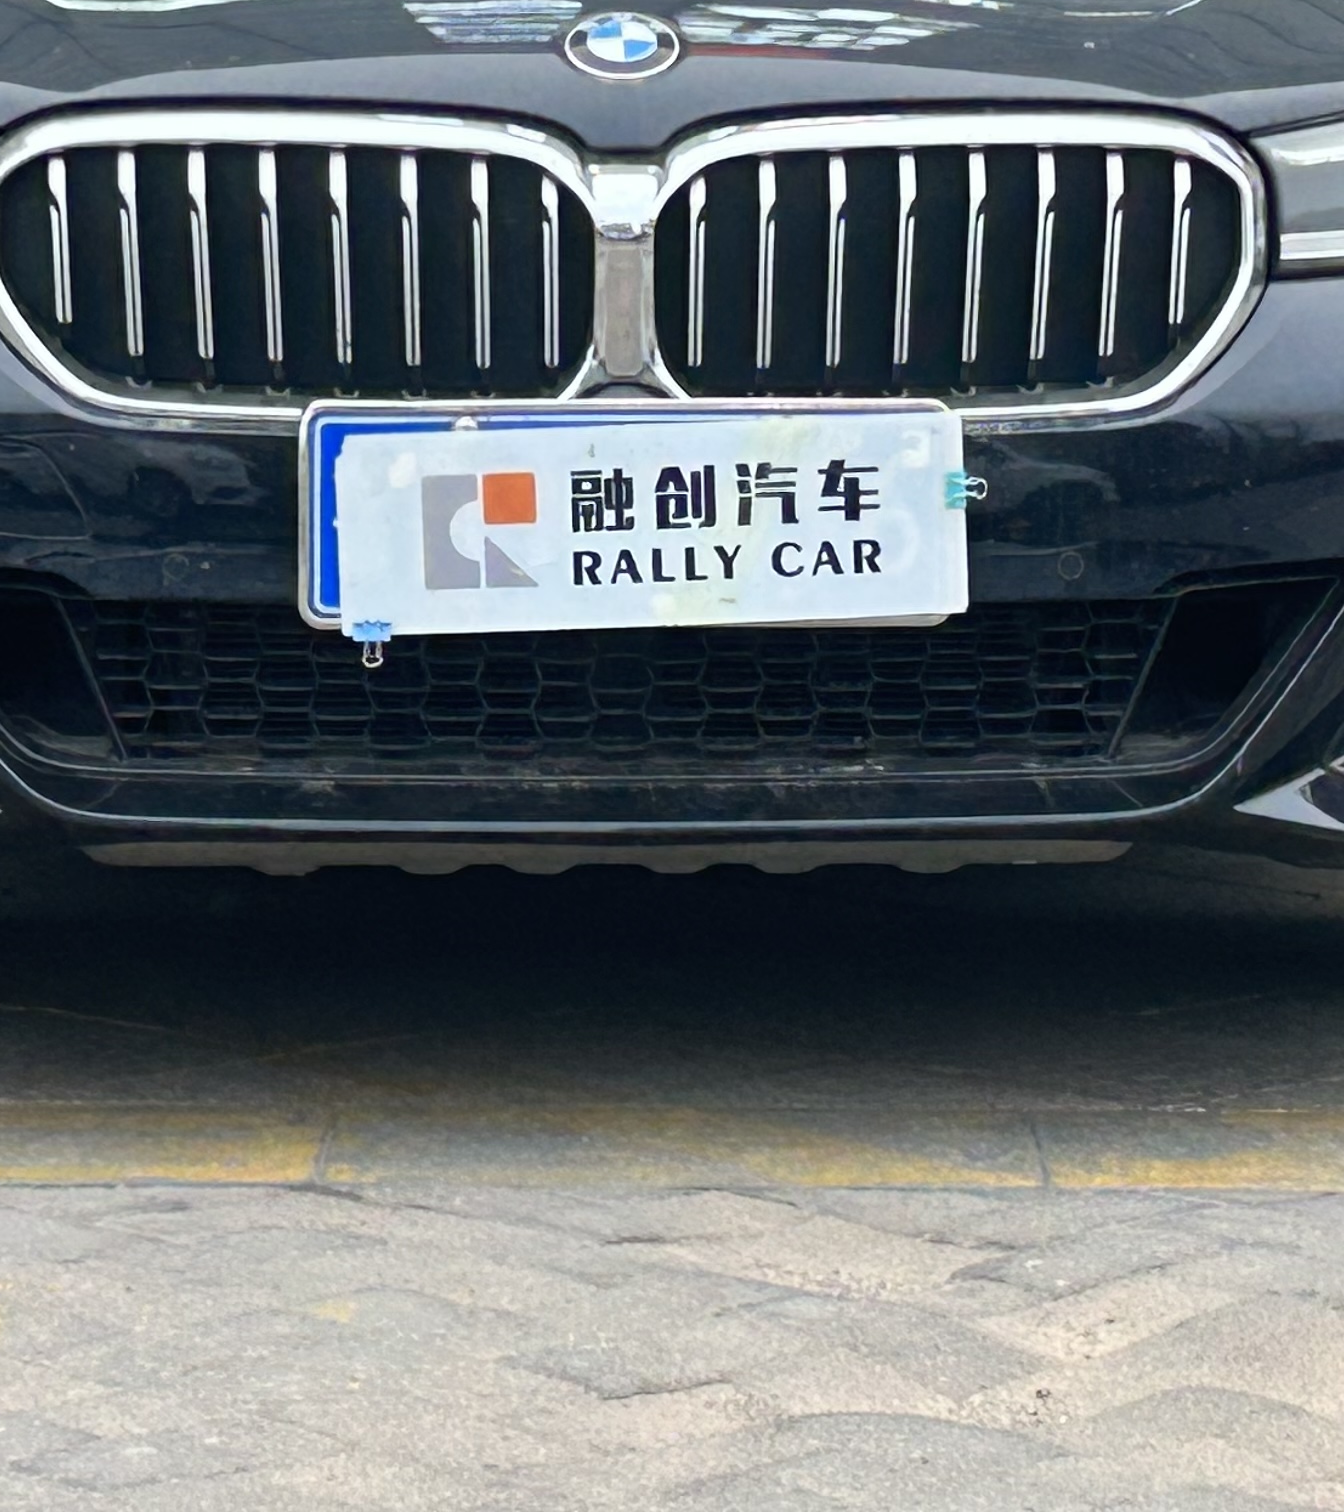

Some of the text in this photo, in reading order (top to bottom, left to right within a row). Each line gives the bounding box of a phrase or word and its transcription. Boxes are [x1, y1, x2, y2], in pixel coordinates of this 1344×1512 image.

[570, 459, 881, 533] 融创汽车
[572, 539, 883, 586] RALLY CAR
